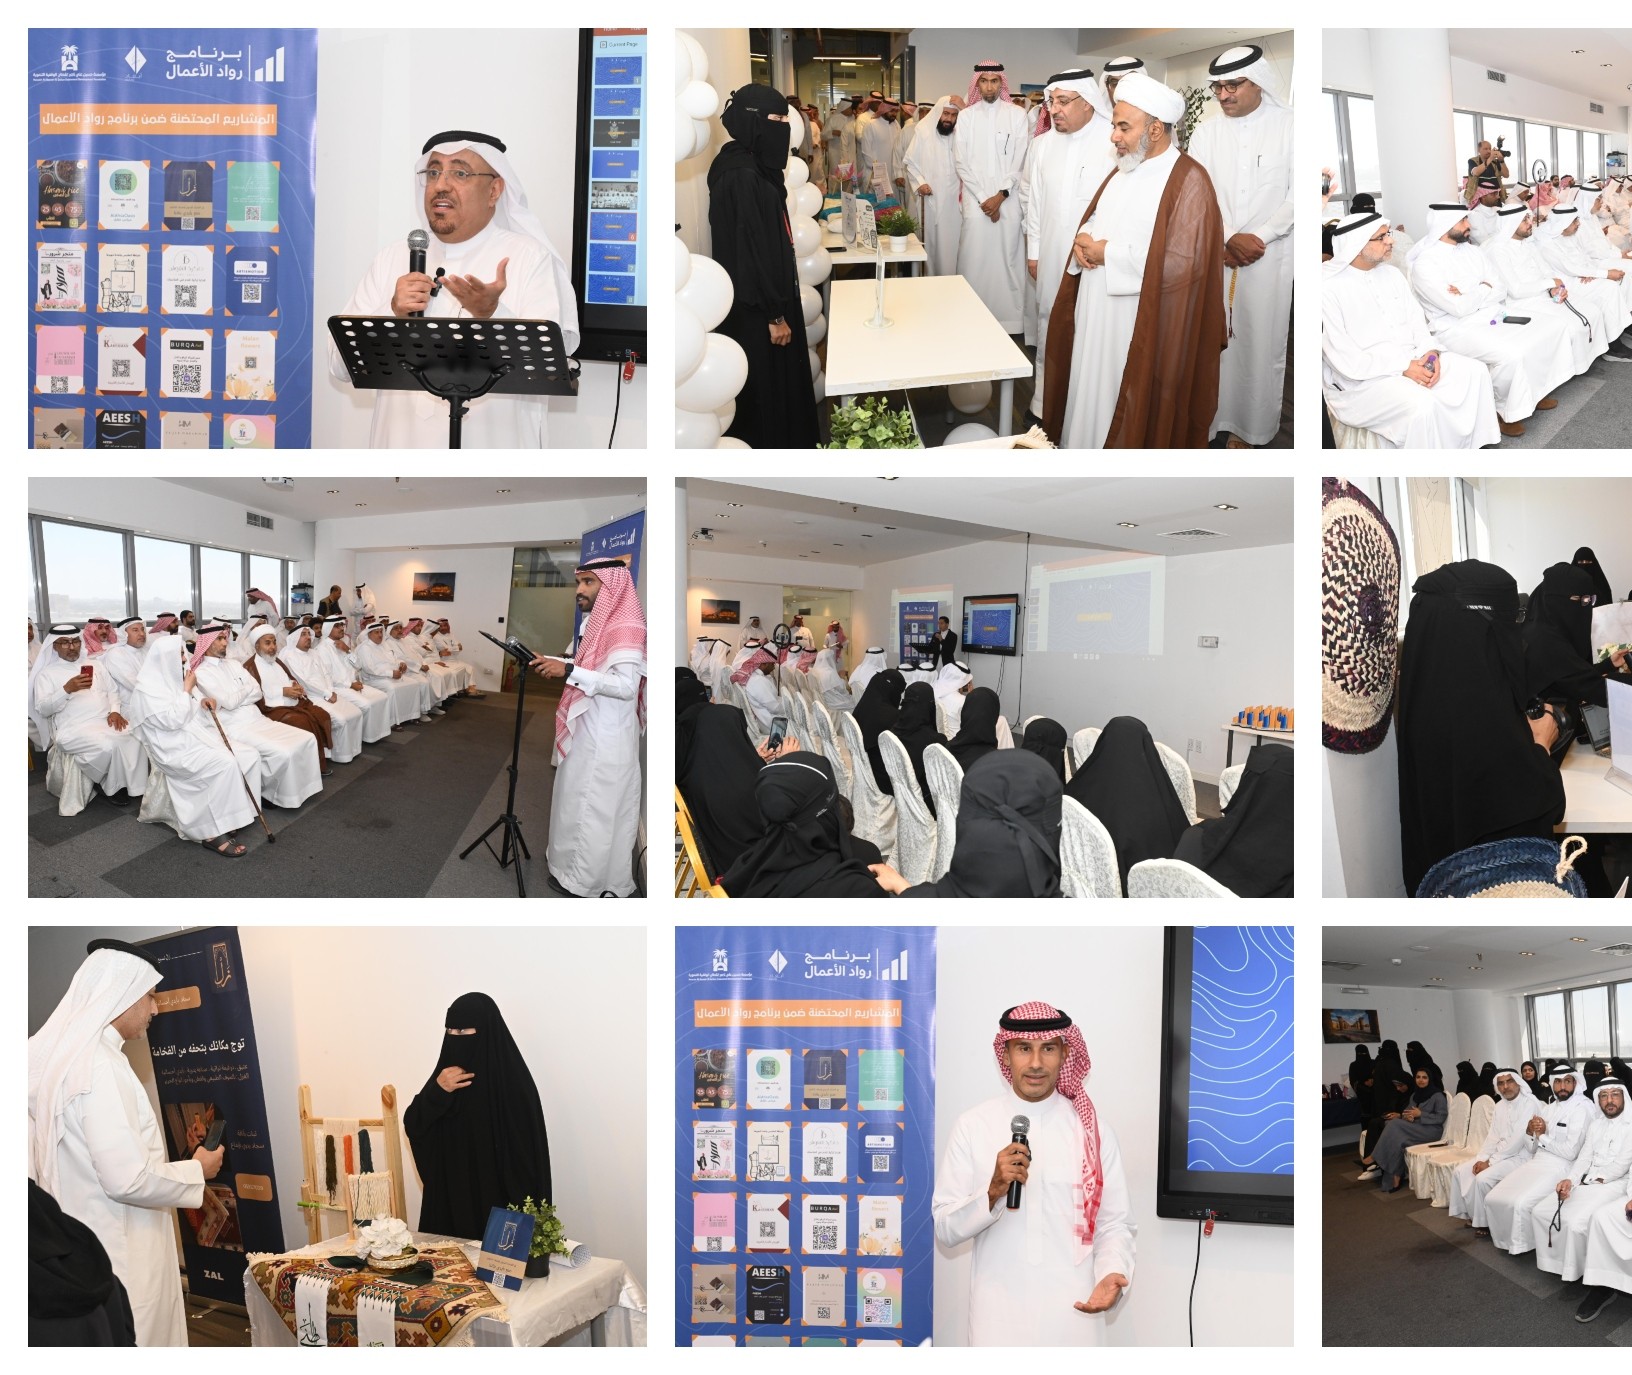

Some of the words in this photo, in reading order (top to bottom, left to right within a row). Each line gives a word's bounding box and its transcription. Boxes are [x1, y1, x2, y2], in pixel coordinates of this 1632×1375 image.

[166, 44, 242, 63] برنامج
[166, 62, 214, 81] الأعمال
[216, 65, 243, 81] رواد
[42, 112, 81, 125] الأعمال
[84, 113, 105, 126] رواد
[107, 113, 138, 126] برنامج
[141, 113, 167, 125] ضمن
[170, 112, 219, 125] المحتضنة
[223, 112, 275, 126] المشاريع
[804, 949, 871, 964] برنامج
[804, 965, 847, 979] الأعمال
[848, 967, 872, 979] رواد
[697, 1007, 731, 1018] الأعمال
[753, 1008, 781, 1019] برنامج
[783, 1008, 806, 1018] ضمن
[808, 1008, 852, 1018] المحتضنة
[854, 1007, 900, 1019] المشاريع
[151, 1045, 176, 1056] الفخامة
[188, 1043, 207, 1055] بتحفه
[209, 1040, 229, 1052] مكانك
[230, 1038, 244, 1053] توج
[178, 1047, 186, 1057] من
[203, 1269, 225, 1281] ZAL
